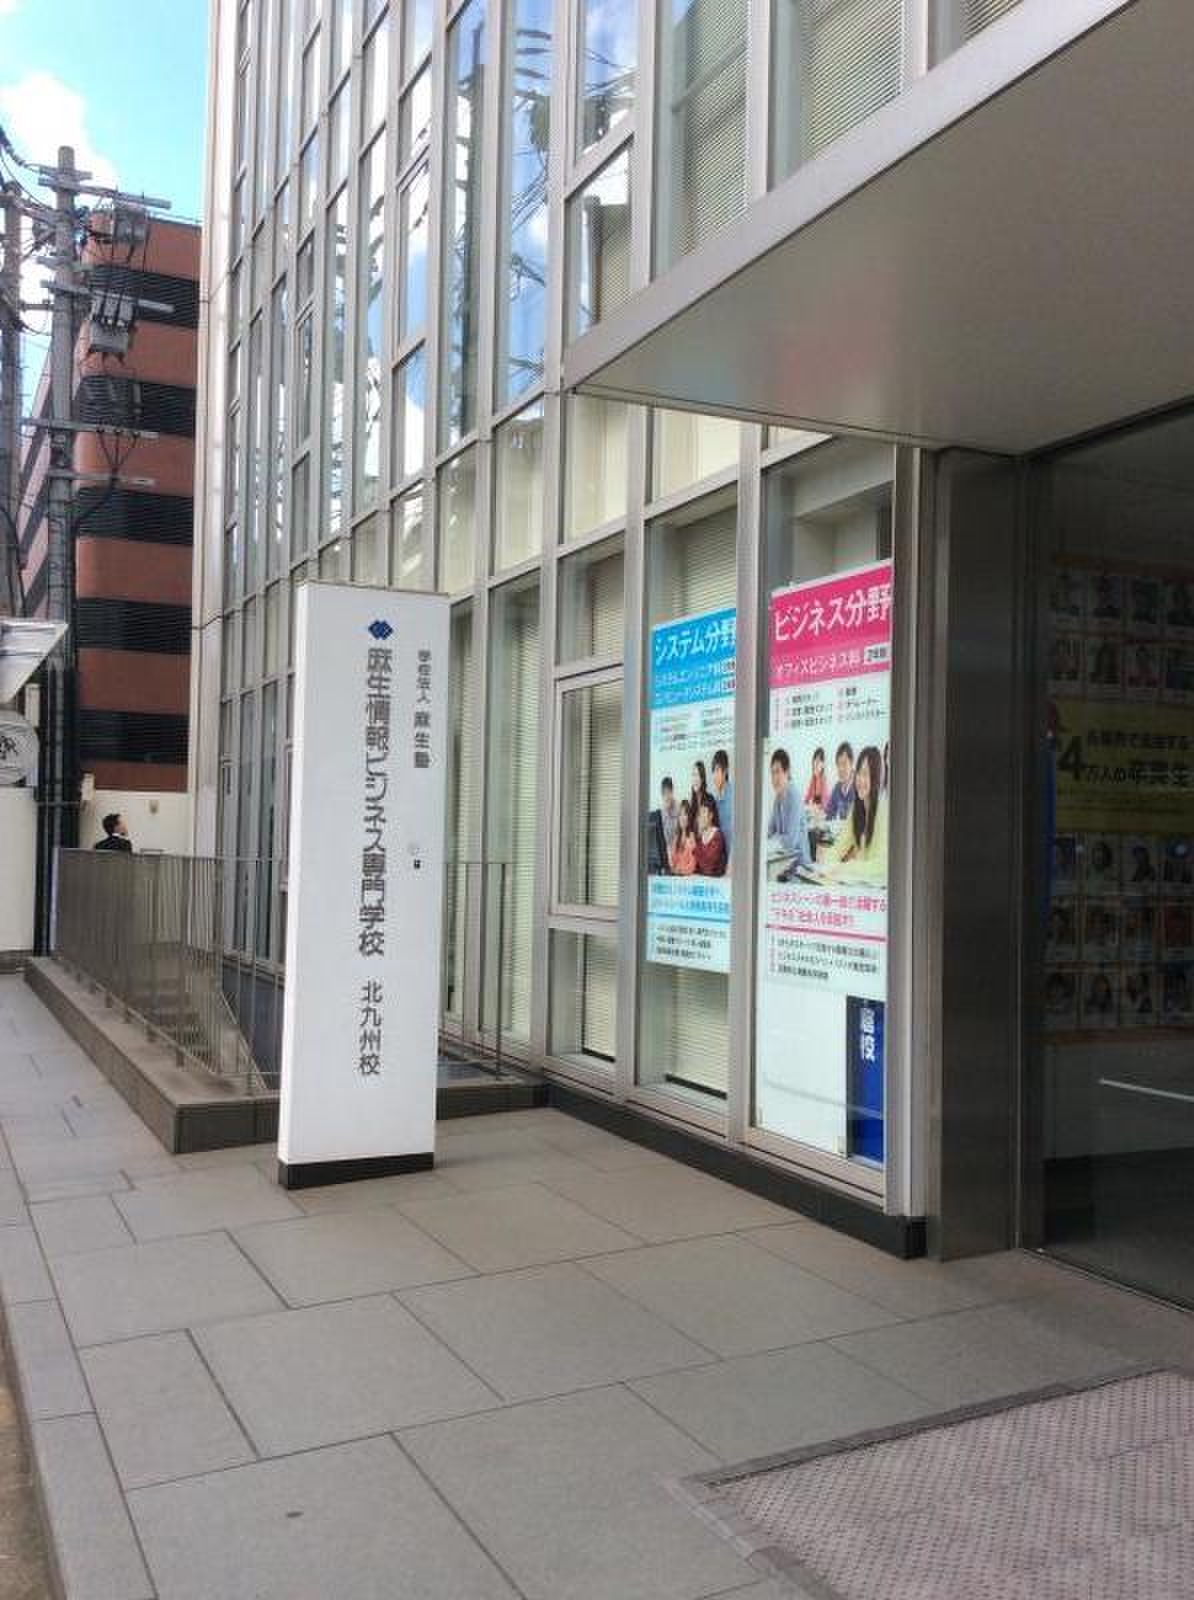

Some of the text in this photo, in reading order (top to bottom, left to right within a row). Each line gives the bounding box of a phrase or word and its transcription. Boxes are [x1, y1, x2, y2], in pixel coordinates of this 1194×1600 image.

[656, 617, 736, 666] システム分野
[773, 584, 891, 641] ビジネス分野
[413, 649, 432, 769] 学校法人 麻生塾
[358, 647, 393, 1076] 麻生情報ビジネス専門学校 北九州校
